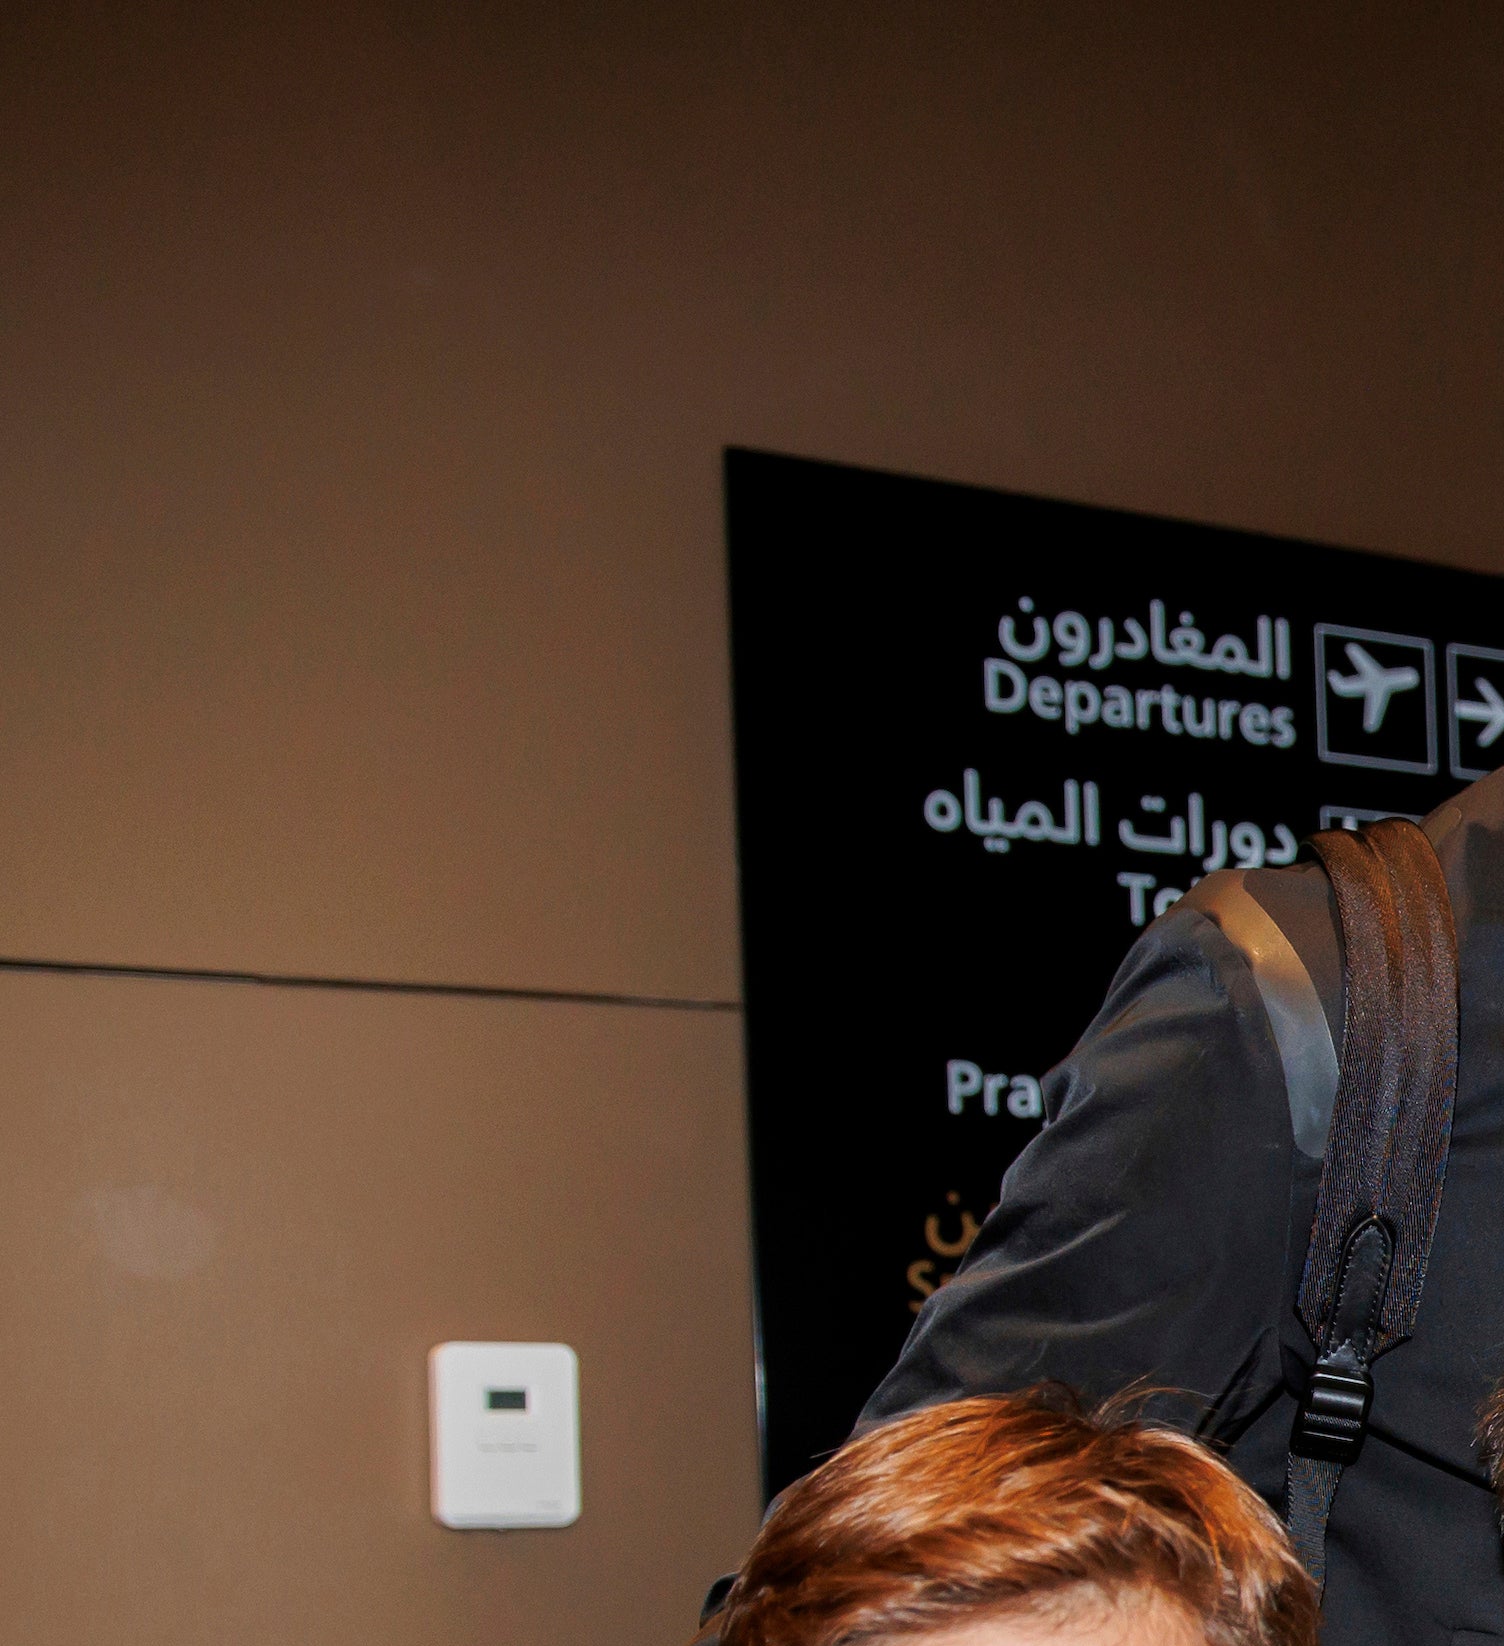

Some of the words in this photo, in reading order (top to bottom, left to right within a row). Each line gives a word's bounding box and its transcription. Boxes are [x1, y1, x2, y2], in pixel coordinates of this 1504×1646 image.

[998, 595, 1292, 681] المغادرون
[983, 657, 1298, 749] Departures
[923, 767, 1100, 853] المياه
[1118, 792, 1299, 871] دورات
[946, 1058, 1051, 1130] Pra
